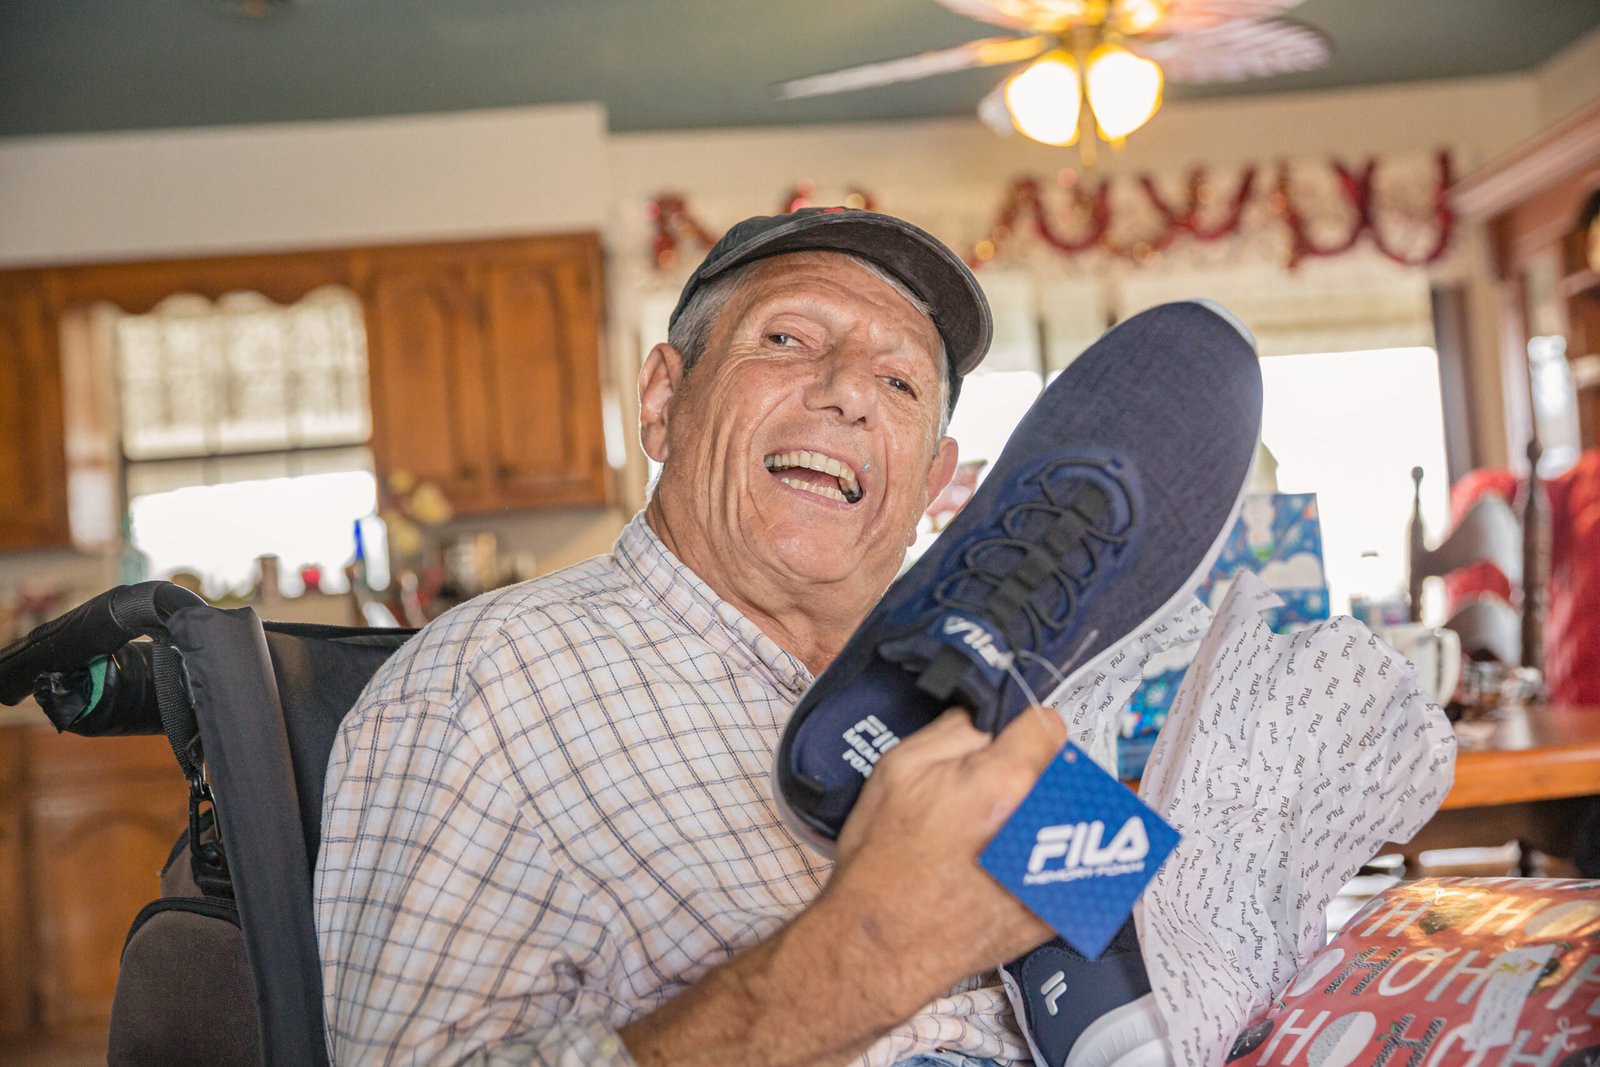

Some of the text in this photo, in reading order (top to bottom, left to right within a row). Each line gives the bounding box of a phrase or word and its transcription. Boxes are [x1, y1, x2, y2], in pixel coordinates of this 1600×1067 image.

[1342, 636, 1357, 657] FILA
[1110, 652, 1126, 669] FILA
[1314, 651, 1328, 669] FILA
[1378, 656, 1392, 676] FILA
[1250, 673, 1261, 695] FILA
[1353, 664, 1366, 684] FILA
[1298, 687, 1312, 706] FILA
[1325, 677, 1340, 696] FILA
[1230, 688, 1240, 710] FILA
[1286, 695, 1294, 716] FILA
[1360, 694, 1376, 714] FILA
[1073, 703, 1088, 725] FILA
[1212, 703, 1222, 725] FILA
[1336, 702, 1351, 722] FILA
[1269, 721, 1277, 744] FILA
[1308, 713, 1323, 733] FILA
[1337, 734, 1352, 754] FILA
[1359, 726, 1375, 747] FILA
[1369, 726, 1387, 746] FILA
[1294, 754, 1305, 775] FILA
[1314, 778, 1331, 794] FILA
[1362, 781, 1380, 796] FILA
[1221, 804, 1244, 815] FILA
[1279, 796, 1289, 817] FILA
[1327, 805, 1344, 821] FILA
[1027, 816, 1149, 875] FILA
[1315, 829, 1331, 846] FILA
[1246, 853, 1256, 872] FILA
[1279, 851, 1288, 868] FILA
[1306, 860, 1319, 877] FILA
[1023, 861, 1145, 885] MEMORY FOAM
[1341, 864, 1356, 881] FILA
[1250, 895, 1260, 915] FILA
[1227, 950, 1240, 973] FILA
